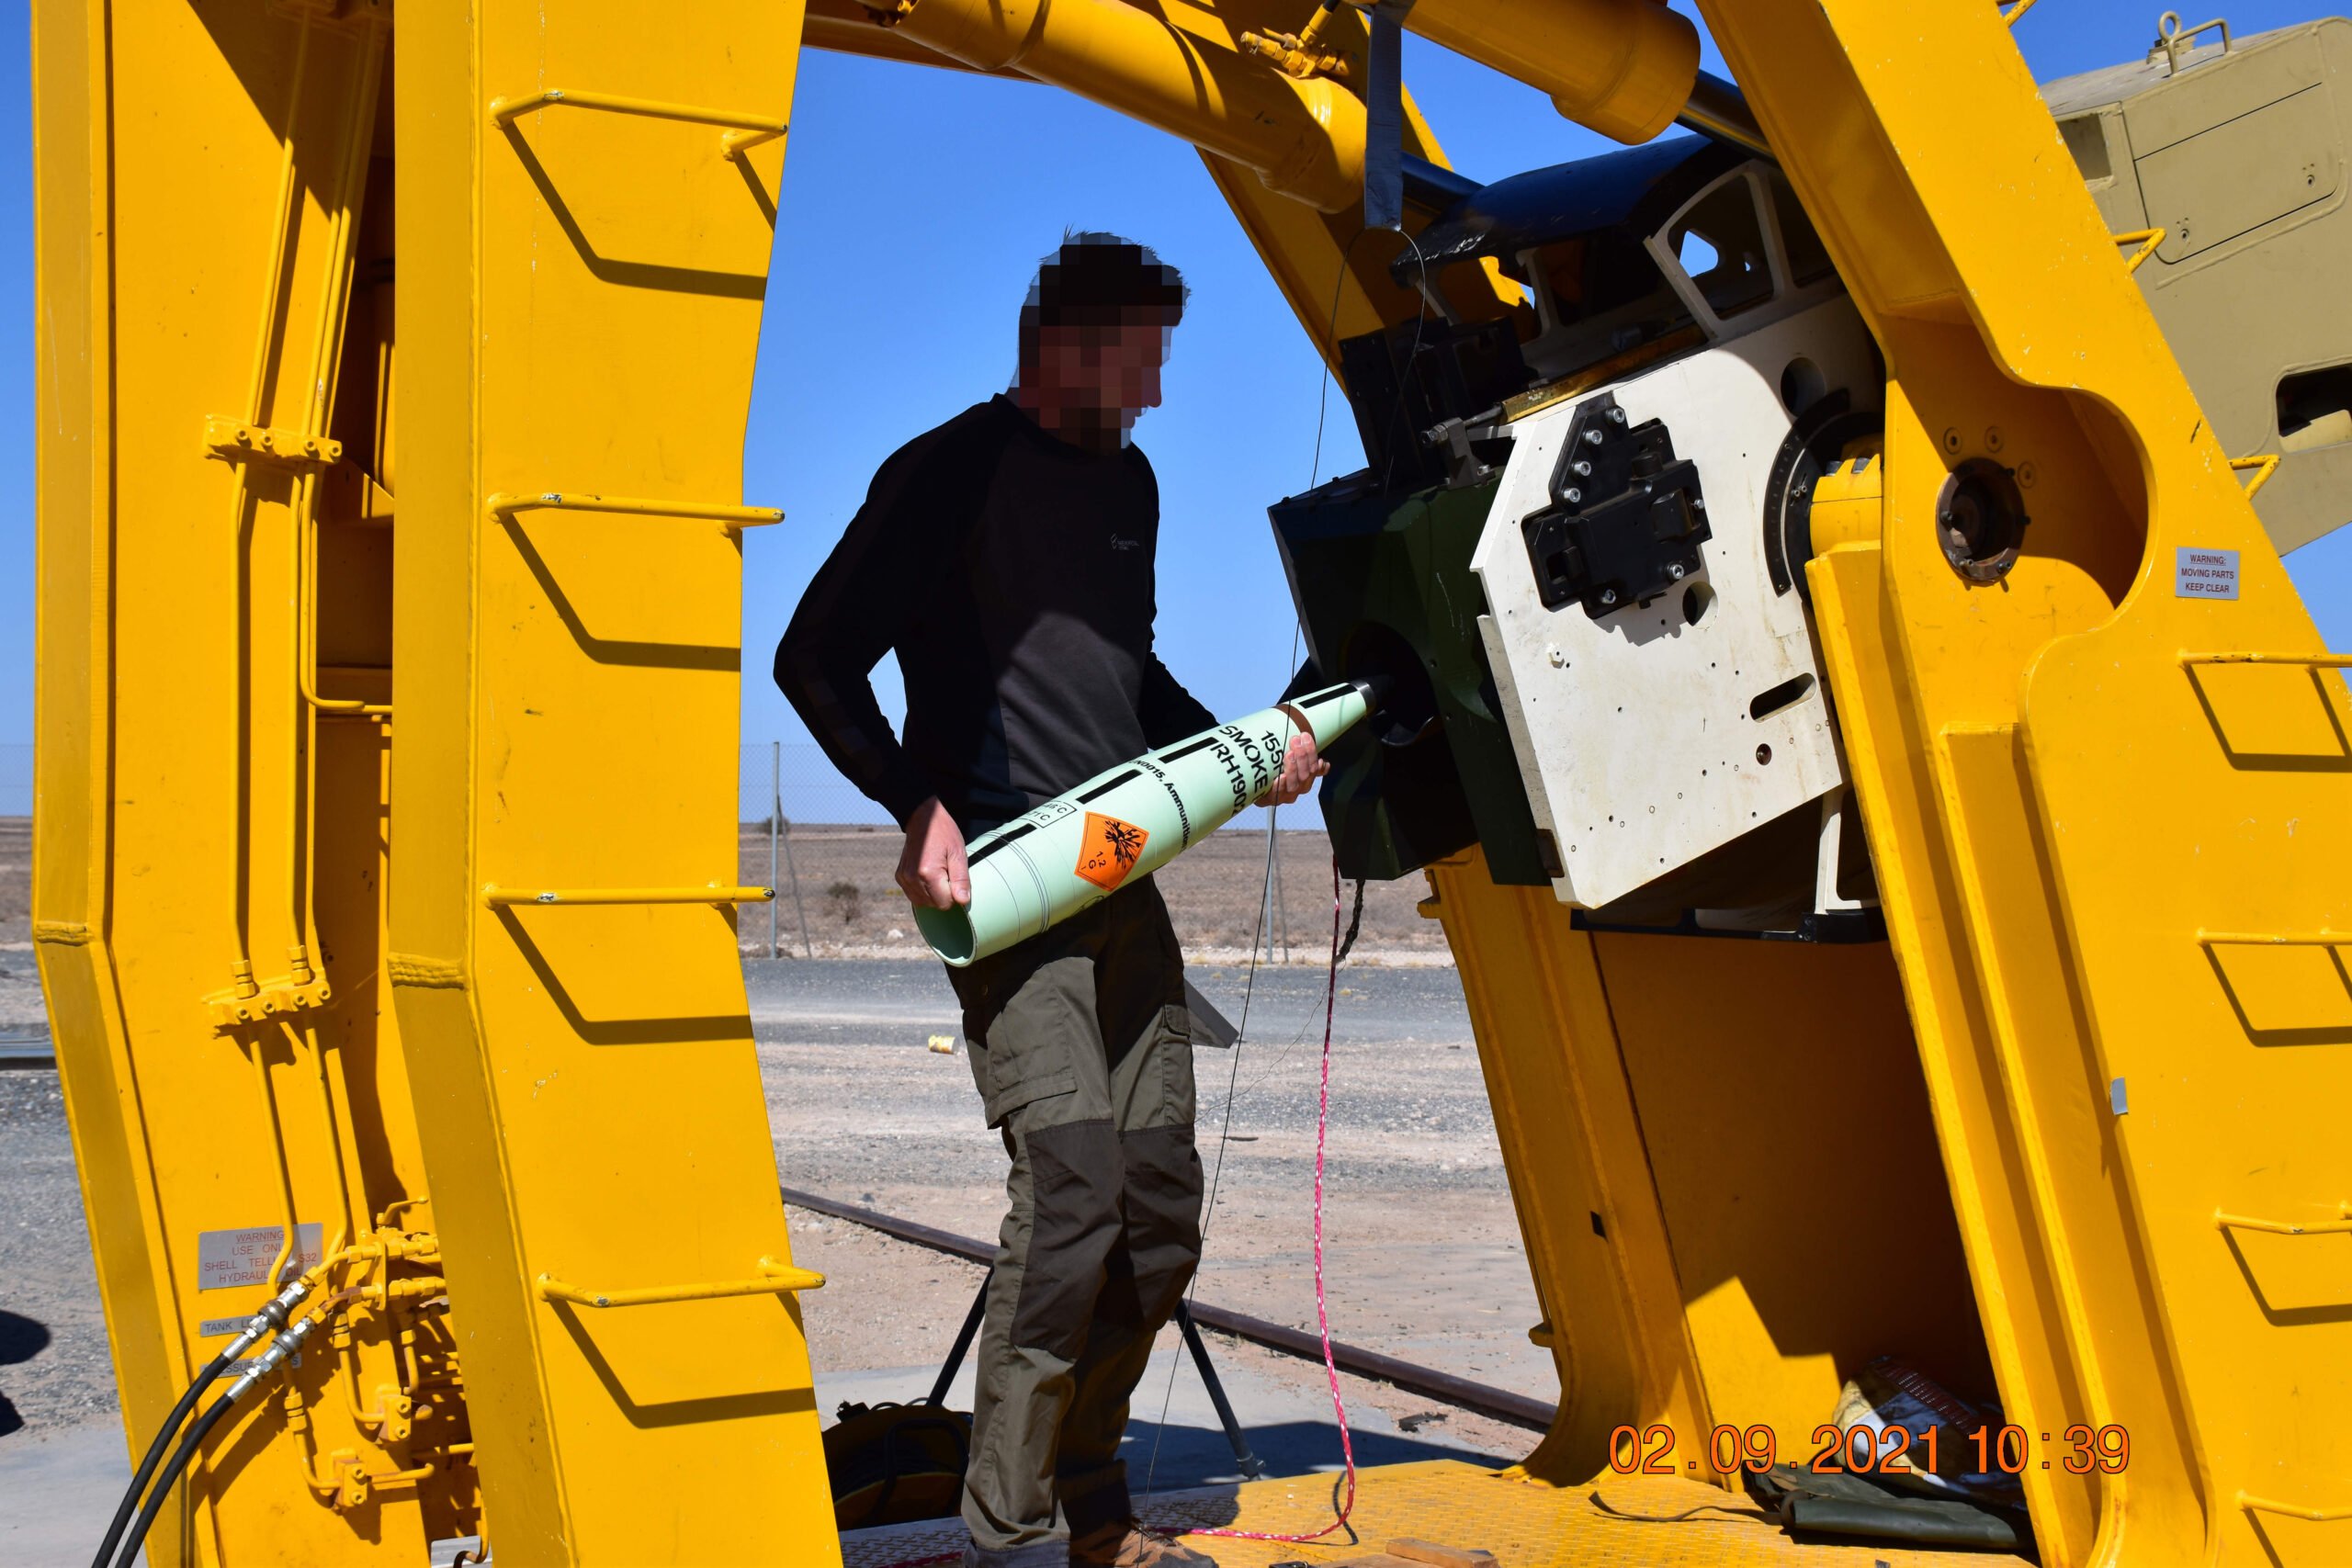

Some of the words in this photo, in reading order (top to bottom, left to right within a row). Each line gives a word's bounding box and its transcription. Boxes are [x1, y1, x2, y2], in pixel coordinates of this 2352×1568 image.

[2190, 554, 2226, 566] WARNING:
[2181, 568, 2210, 578] MOVING
[2211, 570, 2234, 580] PARTS
[2186, 582, 2204, 592] KEEP
[2206, 583, 2230, 592] CLEAR
[1218, 726, 1268, 794] SMOKE
[1088, 859, 1097, 869] G
[232, 1245, 254, 1256] USE
[262, 1242, 282, 1253] ONL
[204, 1259, 237, 1271] SHELL
[249, 1257, 276, 1268] TELL
[299, 1252, 317, 1263] S32
[219, 1270, 269, 1283] HYDRAUL
[286, 1266, 302, 1277] OIL
[205, 1321, 232, 1333] TANK
